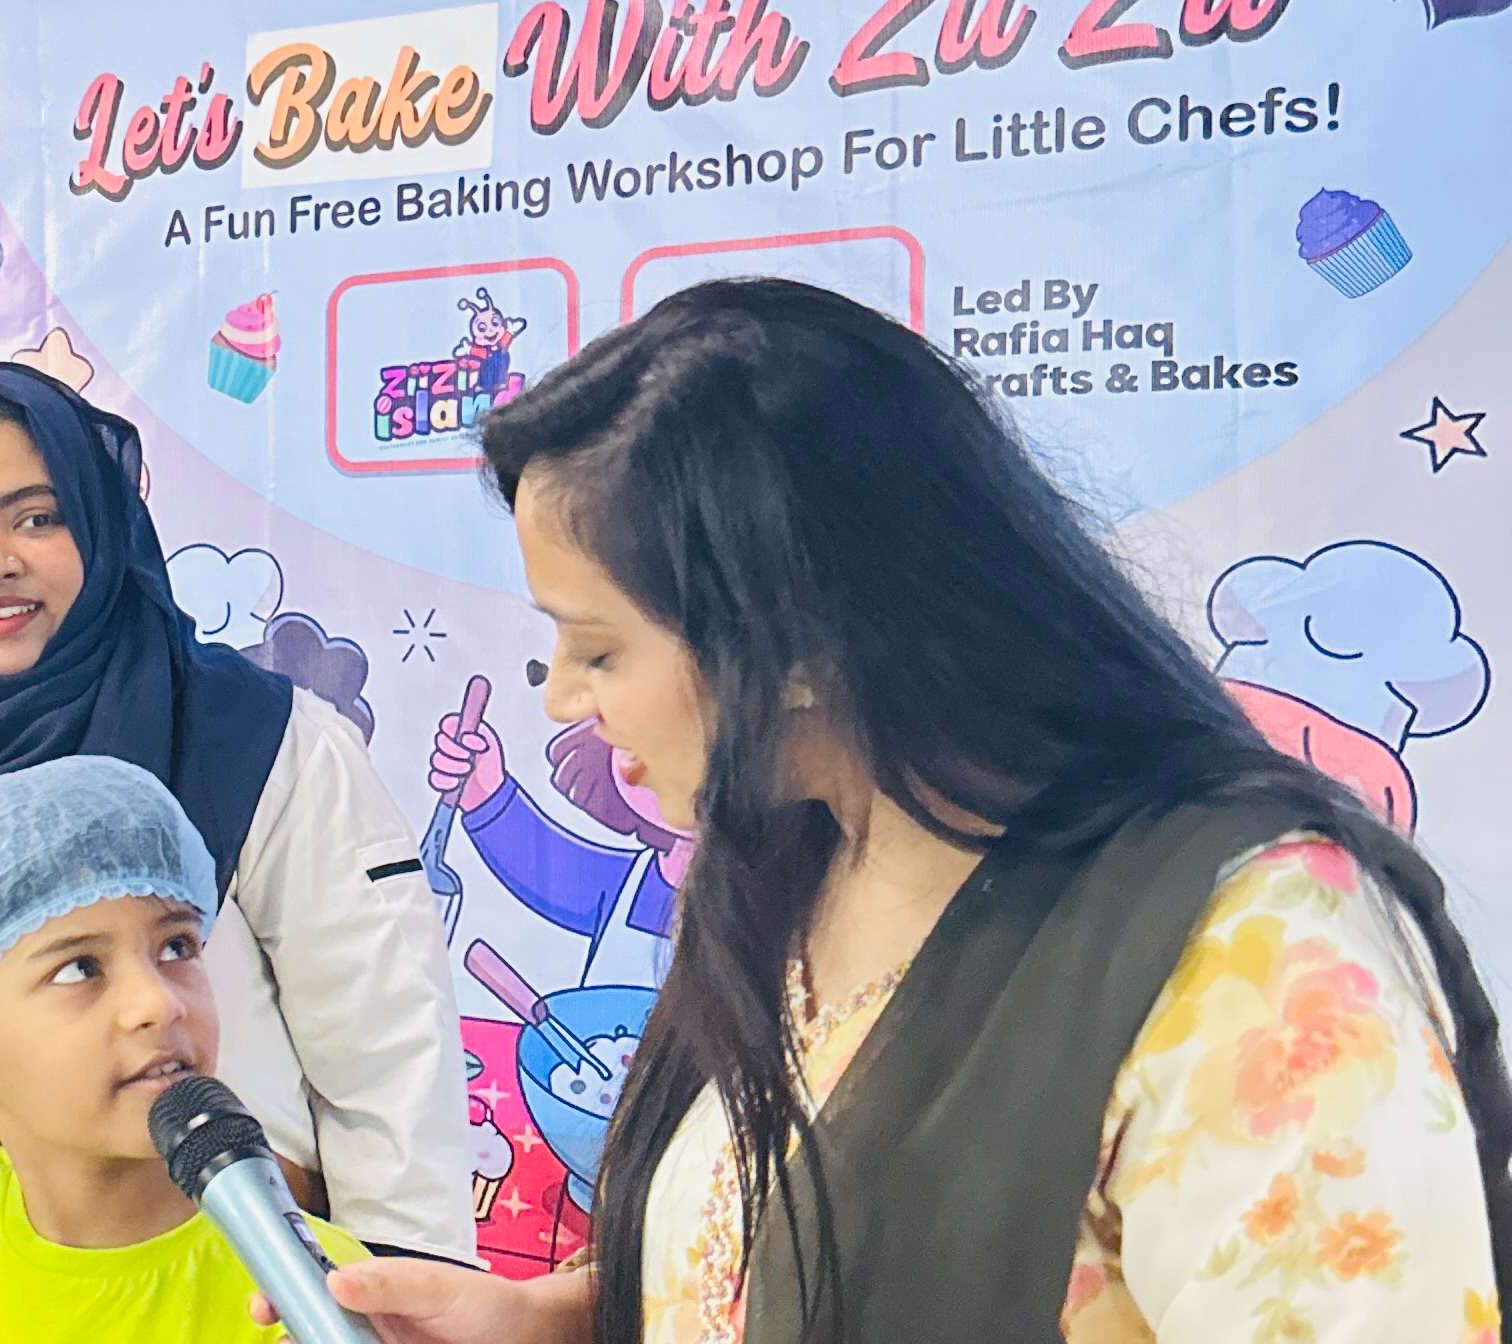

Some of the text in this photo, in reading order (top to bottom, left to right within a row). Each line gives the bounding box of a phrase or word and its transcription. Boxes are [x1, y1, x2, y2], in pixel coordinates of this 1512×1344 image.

[69, 61, 243, 203] Let's
[246, 42, 493, 169] Bake
[164, 81, 1340, 248] A Fun Free Baking Workshop For Little Chefs!
[952, 278, 1100, 319] Led By
[952, 318, 1175, 358] Rafia Haq
[986, 355, 1300, 398] rafts & Bakes
